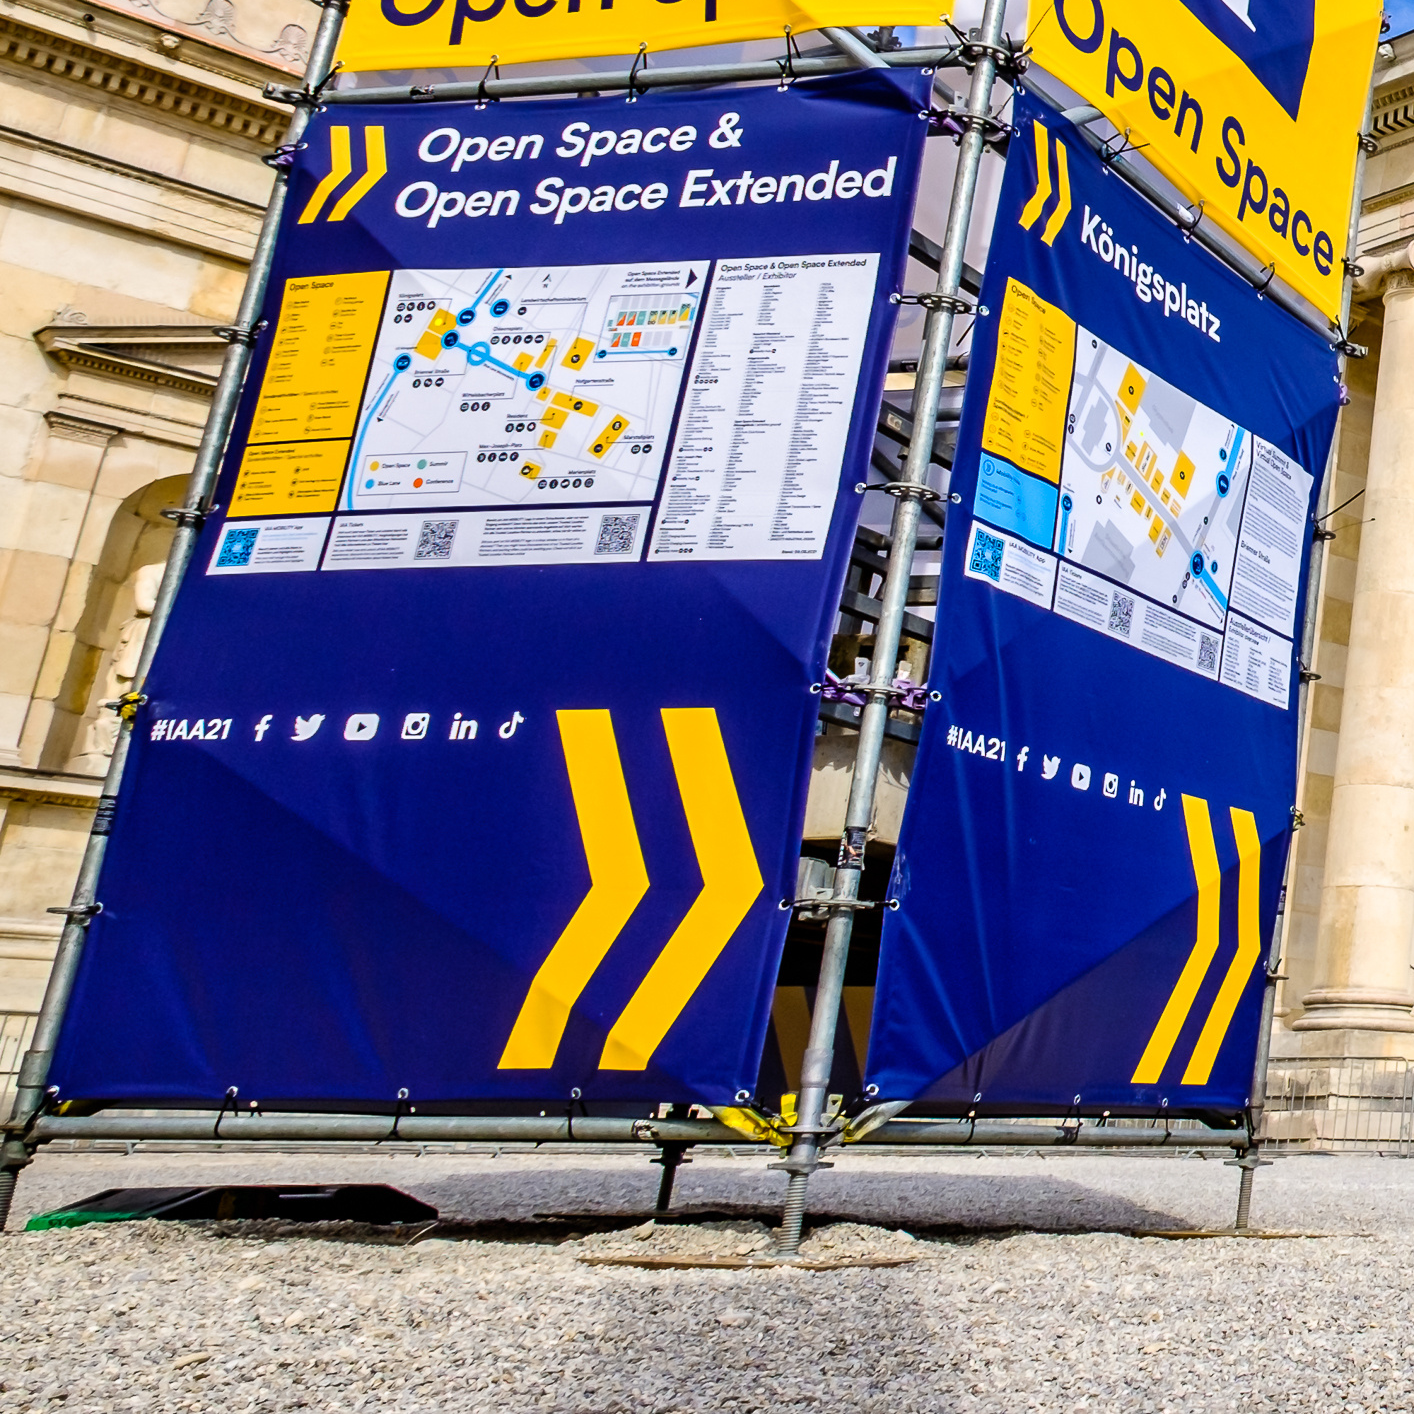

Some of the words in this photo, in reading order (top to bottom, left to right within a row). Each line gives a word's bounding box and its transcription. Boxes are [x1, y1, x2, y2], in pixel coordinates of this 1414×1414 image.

[418, 122, 545, 170] Open
[555, 117, 700, 167] Space
[708, 112, 743, 149] &
[395, 181, 521, 228] Open
[529, 174, 670, 224] Space
[679, 156, 898, 208] Extended
[1216, 118, 1334, 276] Space
[721, 265, 743, 273] Open
[744, 264, 769, 272] Space
[778, 261, 799, 270] Open
[801, 260, 825, 269] Space
[828, 259, 867, 267] Extended
[1080, 204, 1222, 344] Königsplatz
[150, 715, 233, 743] #IAA21
[947, 725, 1006, 762] #IAA21
